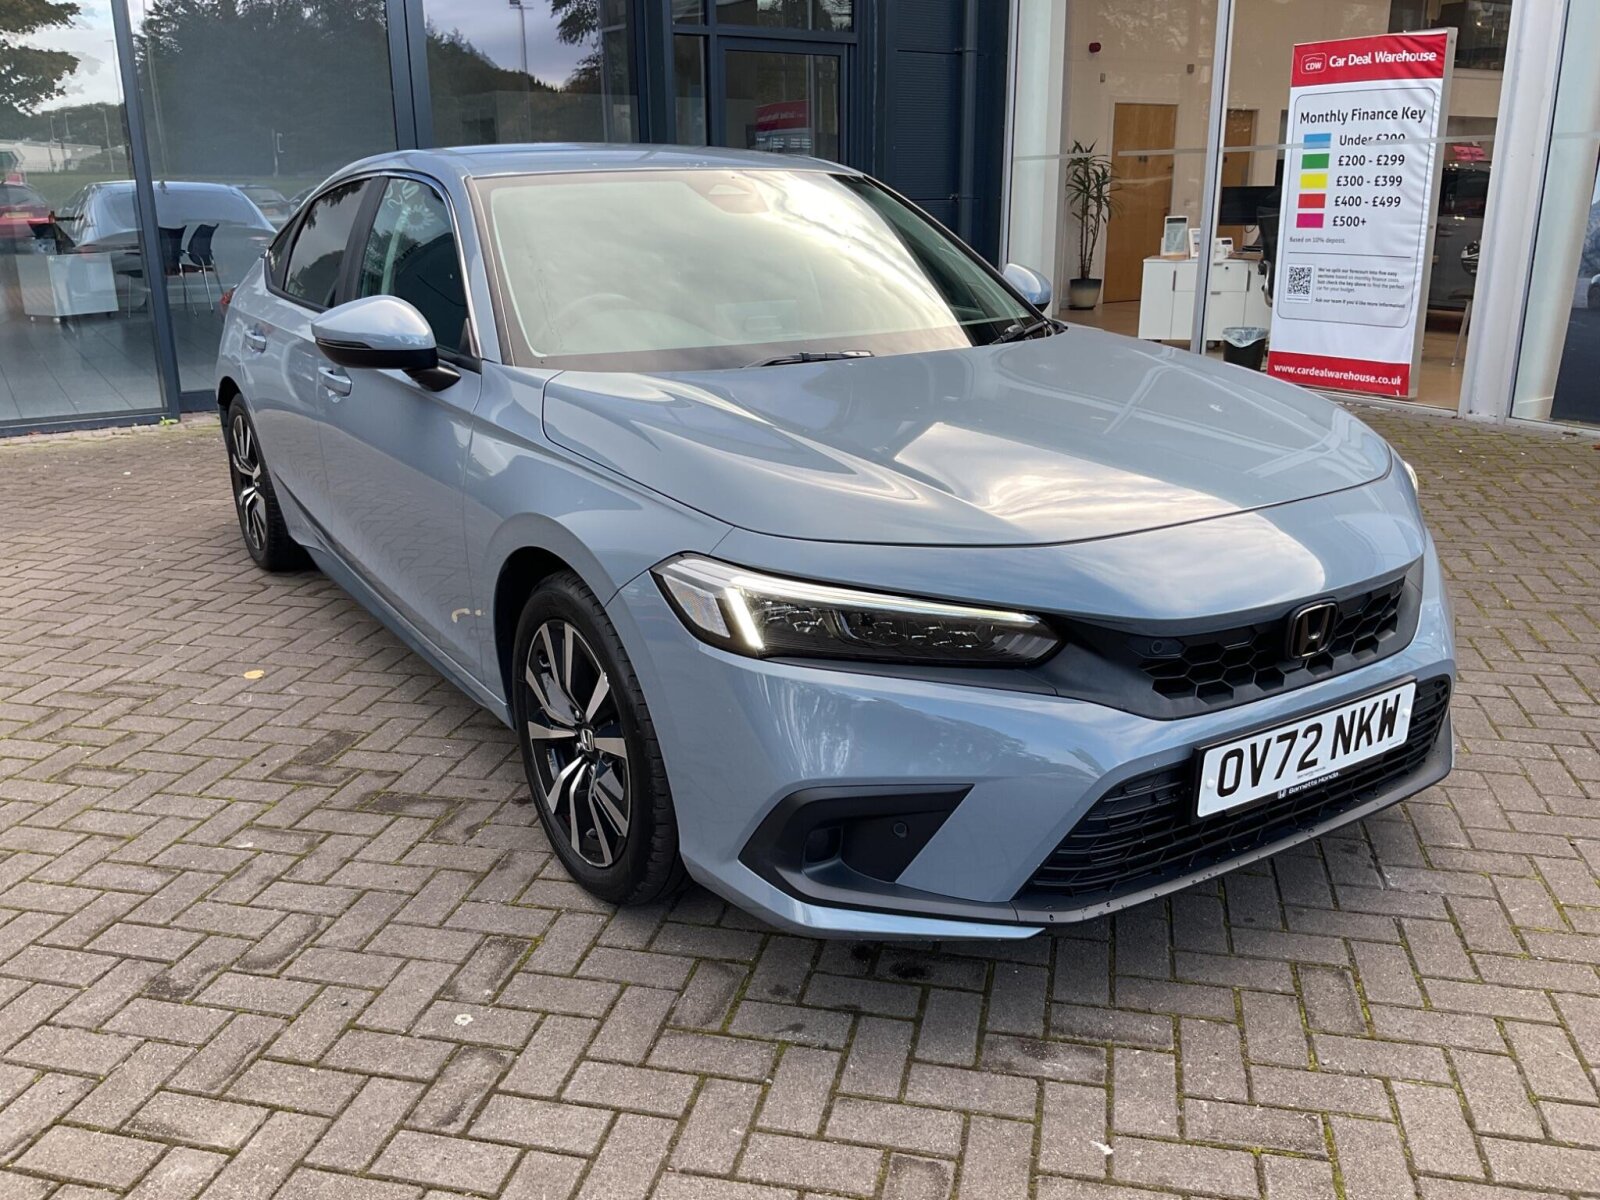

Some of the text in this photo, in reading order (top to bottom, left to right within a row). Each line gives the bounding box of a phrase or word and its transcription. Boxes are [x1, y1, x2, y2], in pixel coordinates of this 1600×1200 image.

[1329, 49, 1437, 68] Car Deal Warehouse
[1305, 62, 1322, 71] CDW
[1300, 106, 1426, 125] Monthly Finance Key
[1340, 133, 1373, 146] Under
[1338, 154, 1366, 167] £200
[1376, 153, 1405, 166] £299
[1336, 175, 1364, 187] £300
[1374, 175, 1403, 187] £399
[1334, 195, 1362, 207] £400
[1372, 195, 1401, 208] £499
[1332, 216, 1367, 227] £500+
[1274, 364, 1401, 385] www.cardealwarehouse.co.uk
[1216, 693, 1401, 797] OV72 NKW
[1318, 771, 1339, 783] Honda
